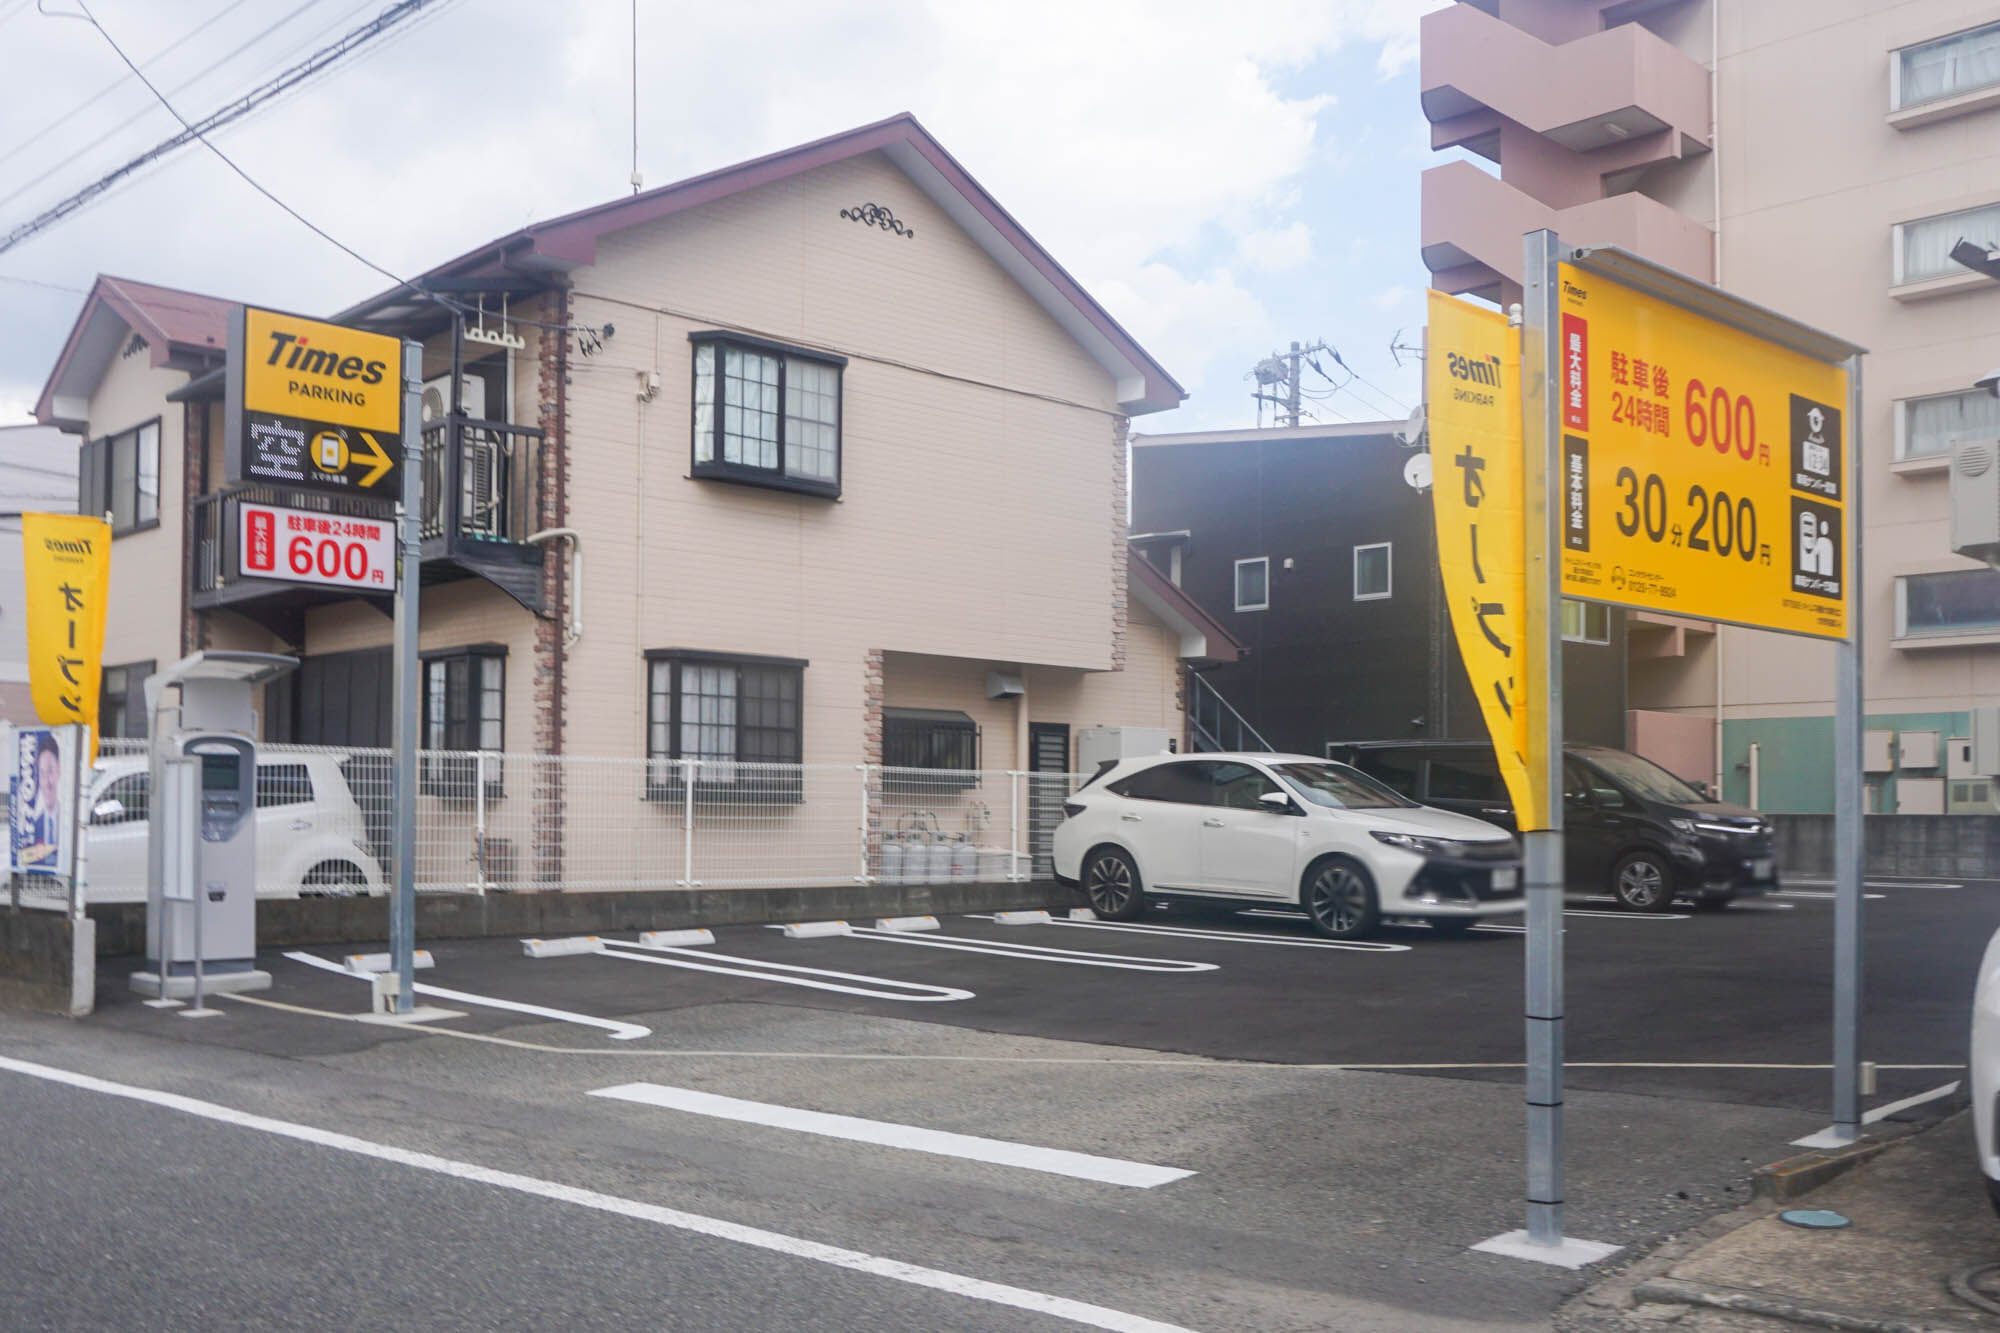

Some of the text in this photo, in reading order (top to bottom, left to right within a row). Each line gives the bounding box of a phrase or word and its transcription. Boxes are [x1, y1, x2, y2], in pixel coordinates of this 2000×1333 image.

[266, 330, 387, 385] Times
[1611, 350, 1670, 400] 駐車後
[288, 380, 367, 407] PARKING
[1611, 391, 1670, 438] 24時間
[250, 419, 304, 481] 空
[288, 514, 381, 542] 駐車後24時間
